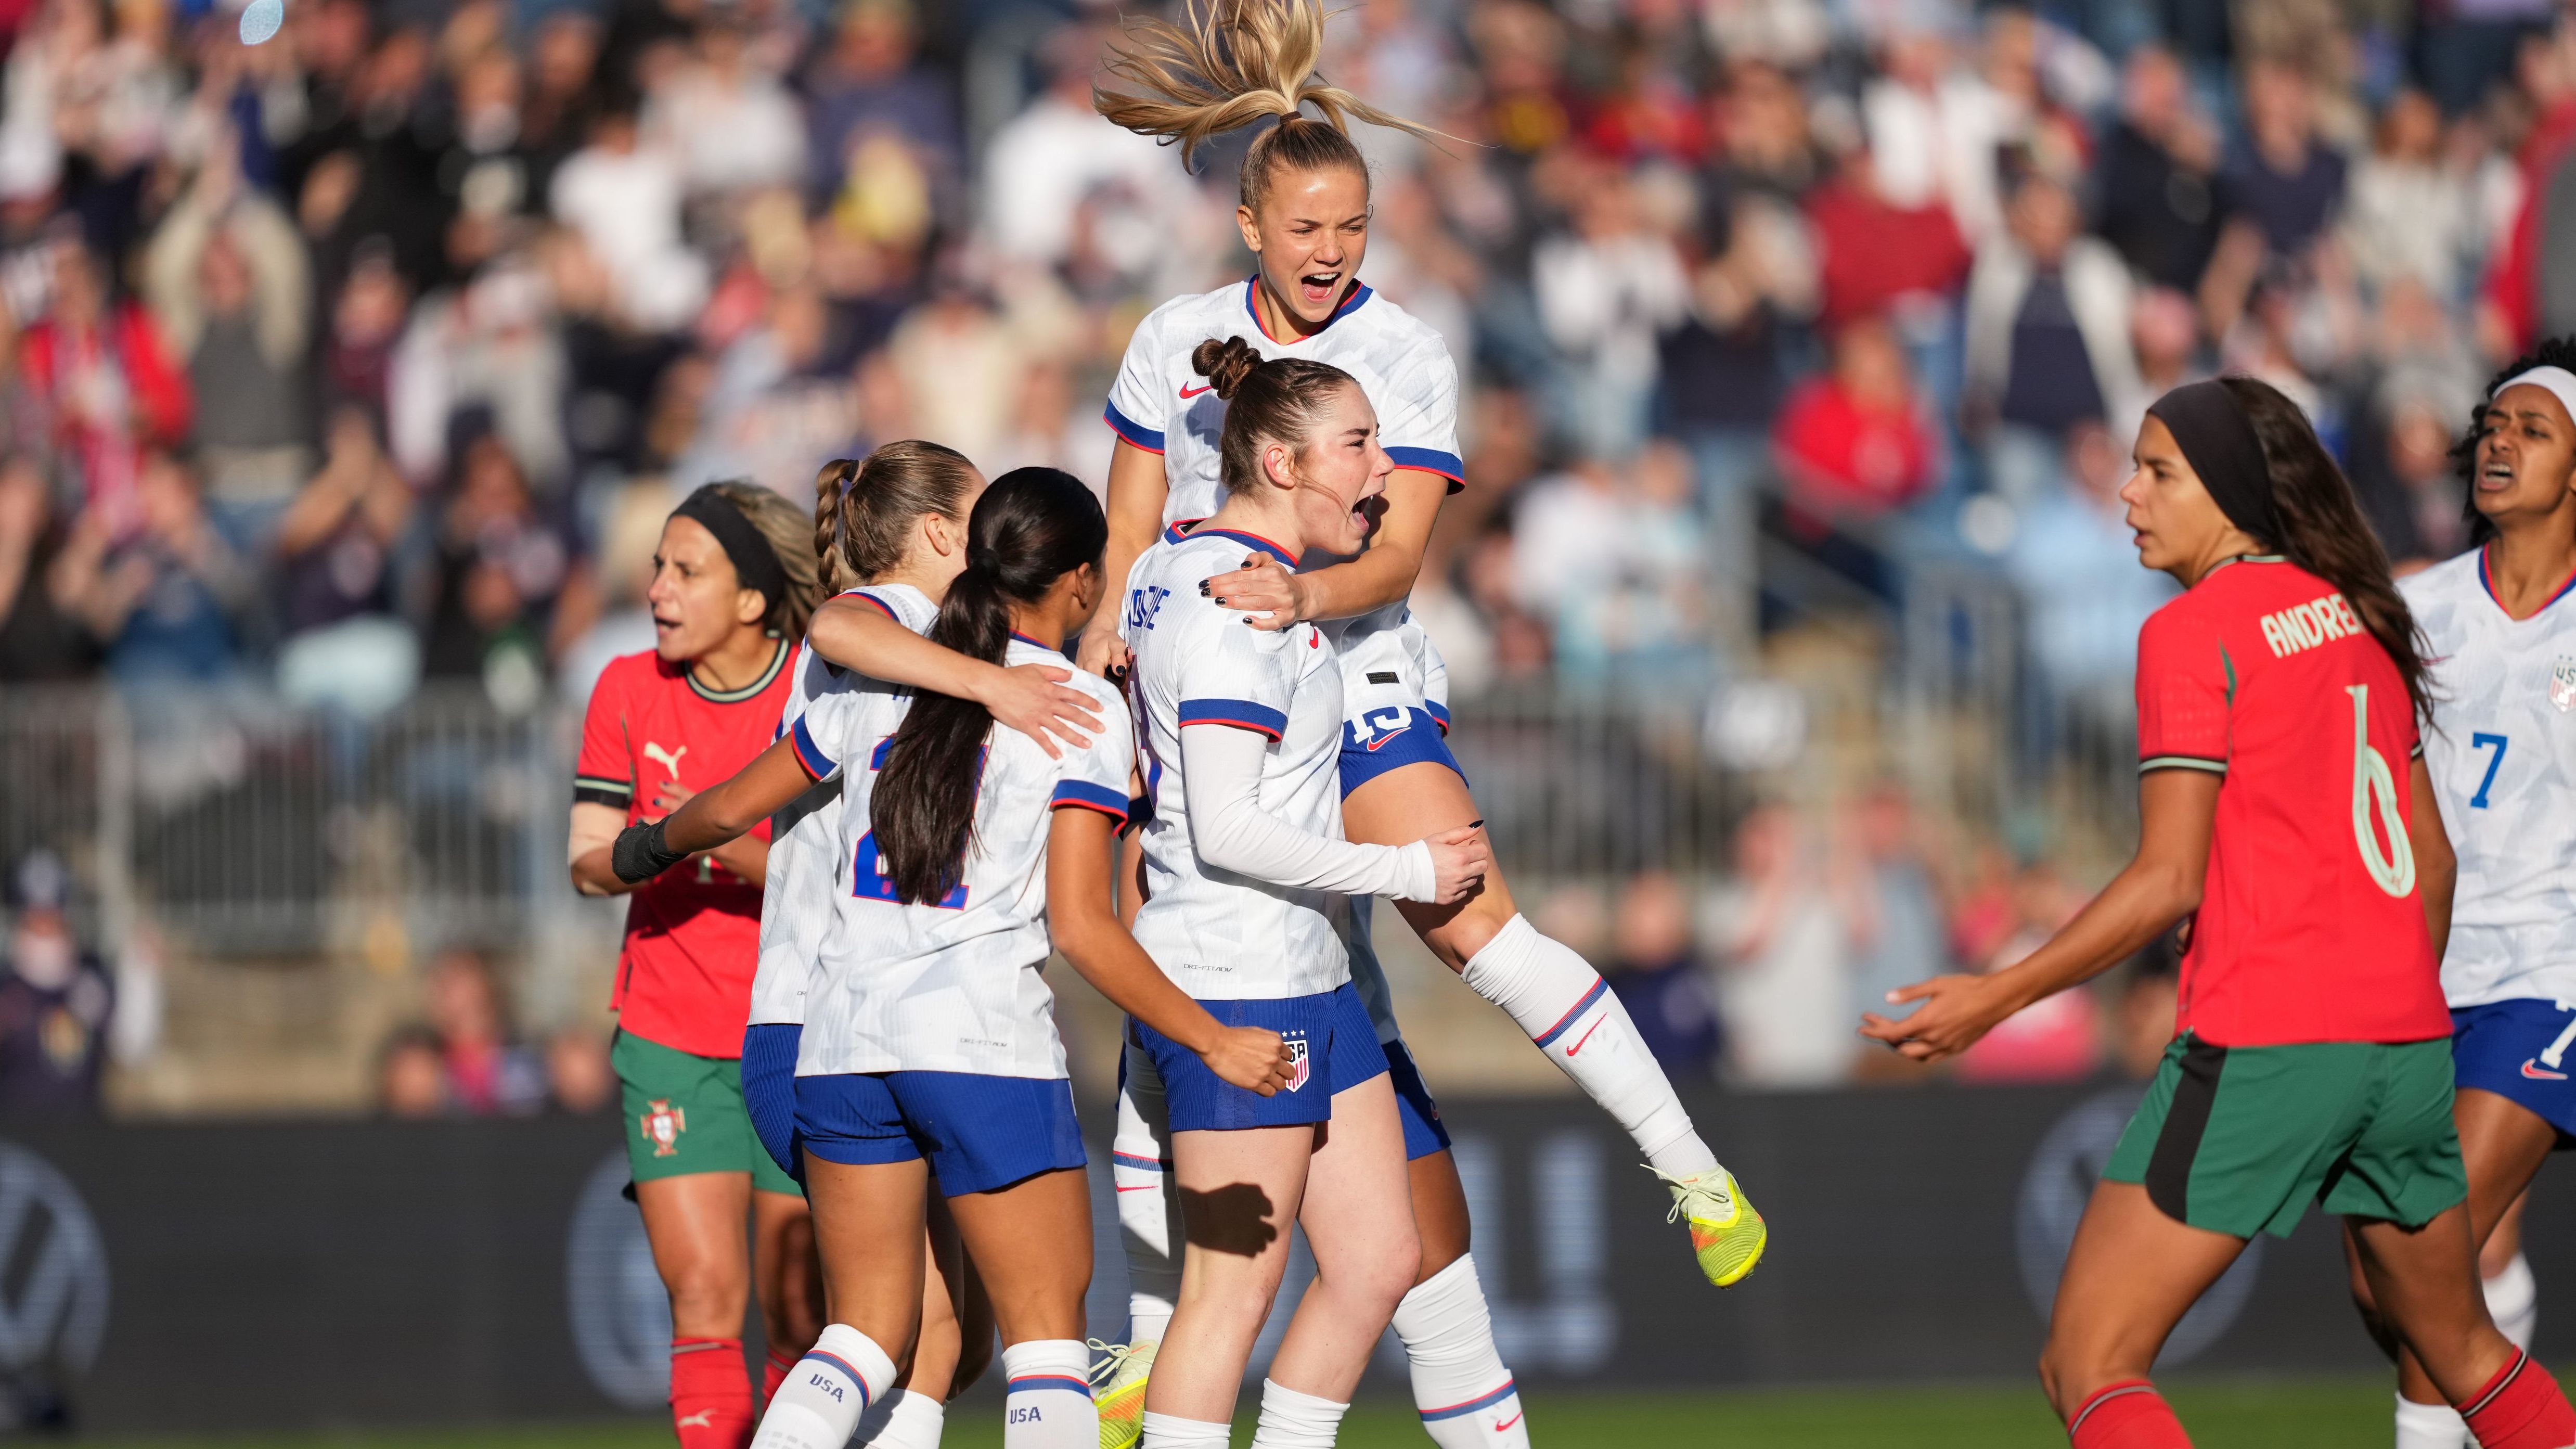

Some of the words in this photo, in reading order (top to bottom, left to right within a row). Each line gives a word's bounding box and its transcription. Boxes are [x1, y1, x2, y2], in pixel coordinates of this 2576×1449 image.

[2345, 684, 2416, 898] 6
[2470, 732, 2508, 809] 7
[809, 1374, 843, 1403] USA
[1010, 1407, 1041, 1424] USA
